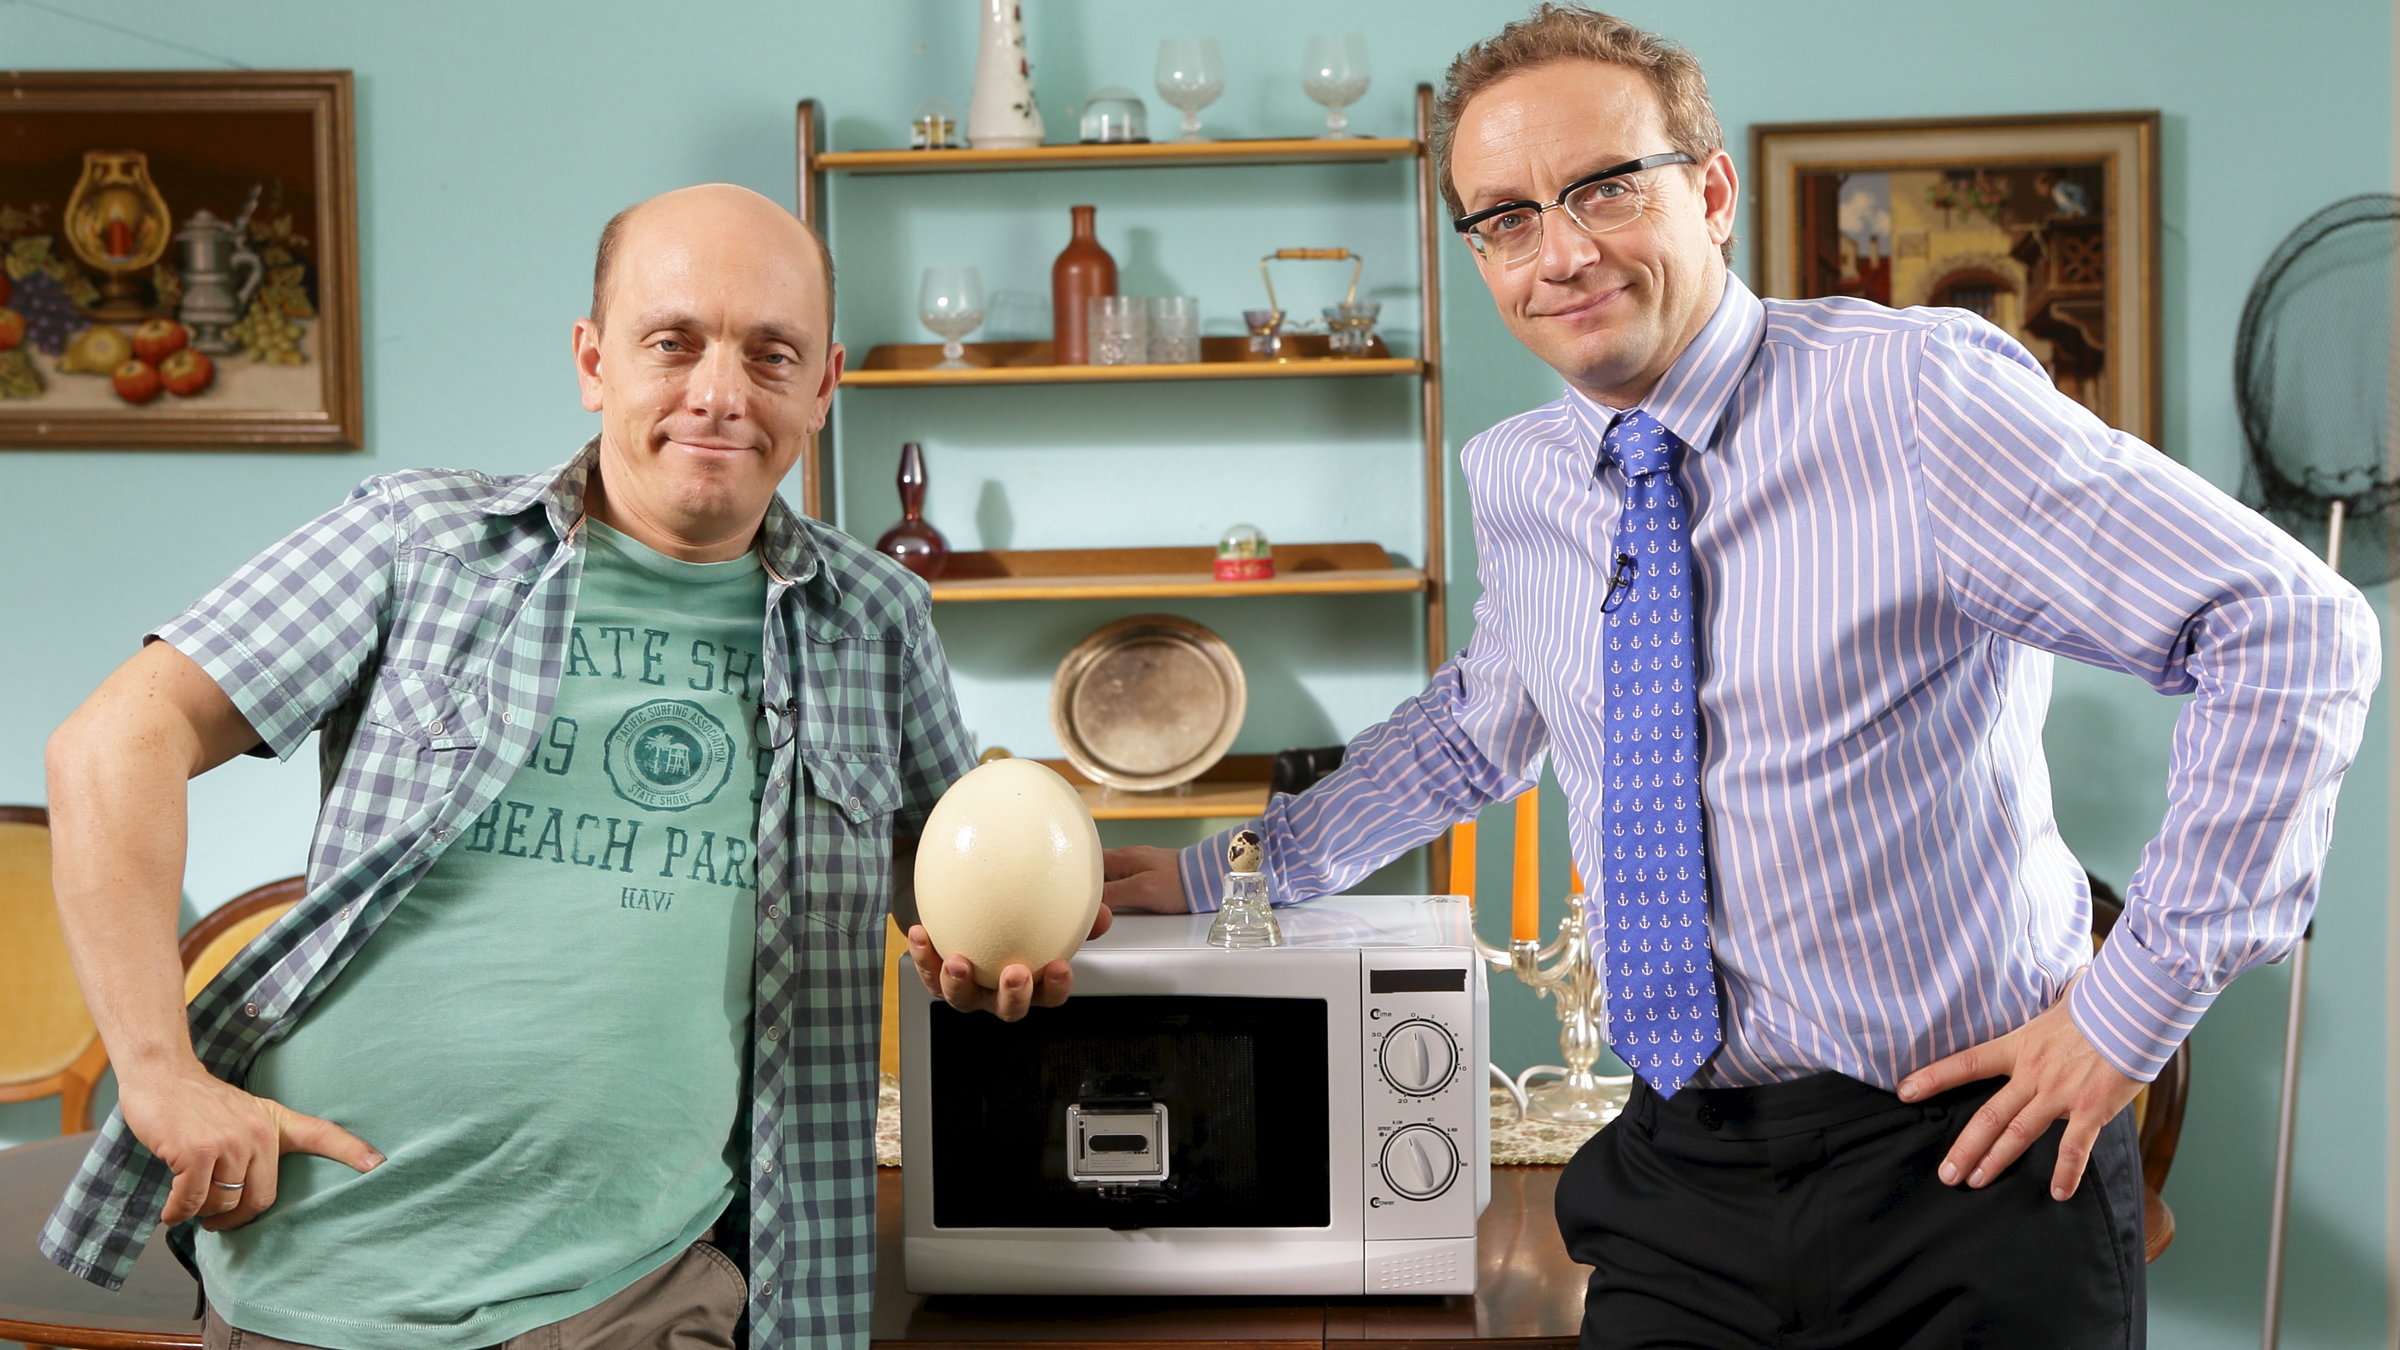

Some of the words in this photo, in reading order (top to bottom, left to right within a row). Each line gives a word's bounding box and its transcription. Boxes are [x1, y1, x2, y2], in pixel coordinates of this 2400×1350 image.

[688, 639, 764, 702] SH
[615, 712, 647, 743] PACIFIC
[648, 704, 689, 718] SURFING
[689, 712, 726, 763] ASSOCIATION
[628, 783, 657, 804] STATE
[660, 792, 692, 805] SHORE
[465, 798, 643, 874] BEACH
[659, 826, 757, 890] PAR
